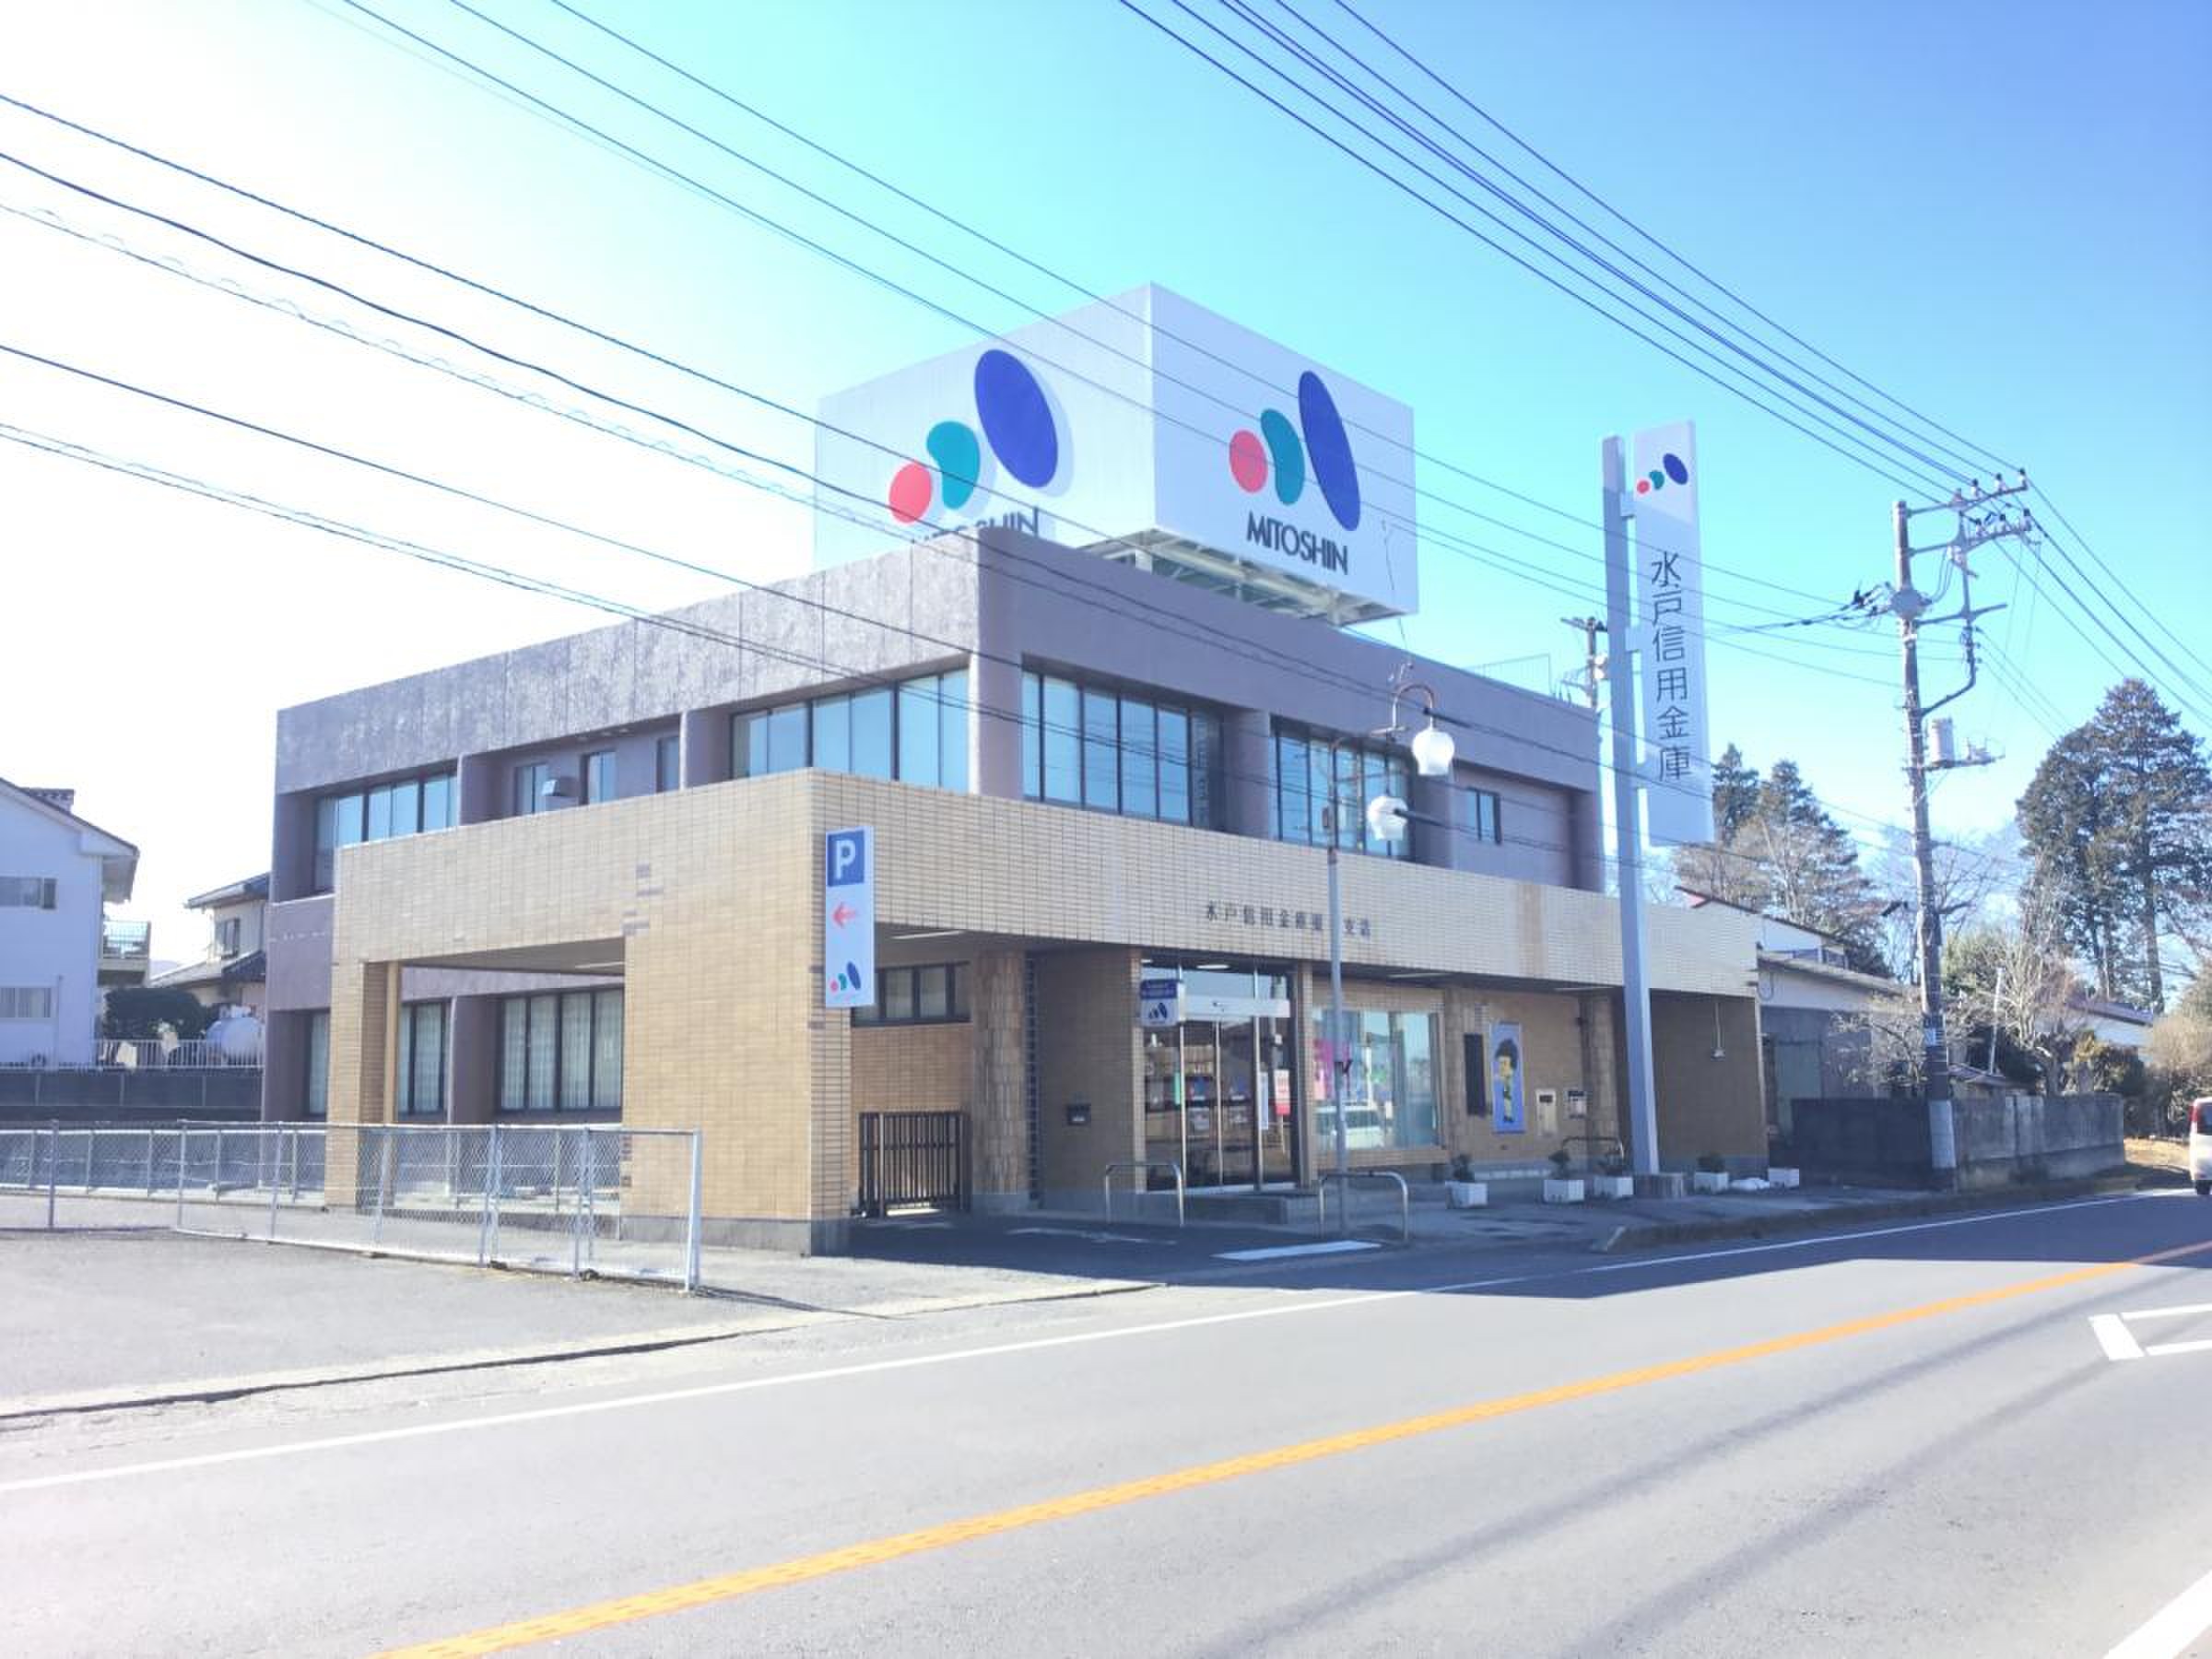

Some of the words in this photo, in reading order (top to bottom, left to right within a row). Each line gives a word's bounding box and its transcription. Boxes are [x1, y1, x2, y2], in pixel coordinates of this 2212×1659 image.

[1246, 511, 1348, 575] MITOSHIN
[1652, 550, 1691, 782] 水戸信用金庫
[835, 840, 856, 879] P
